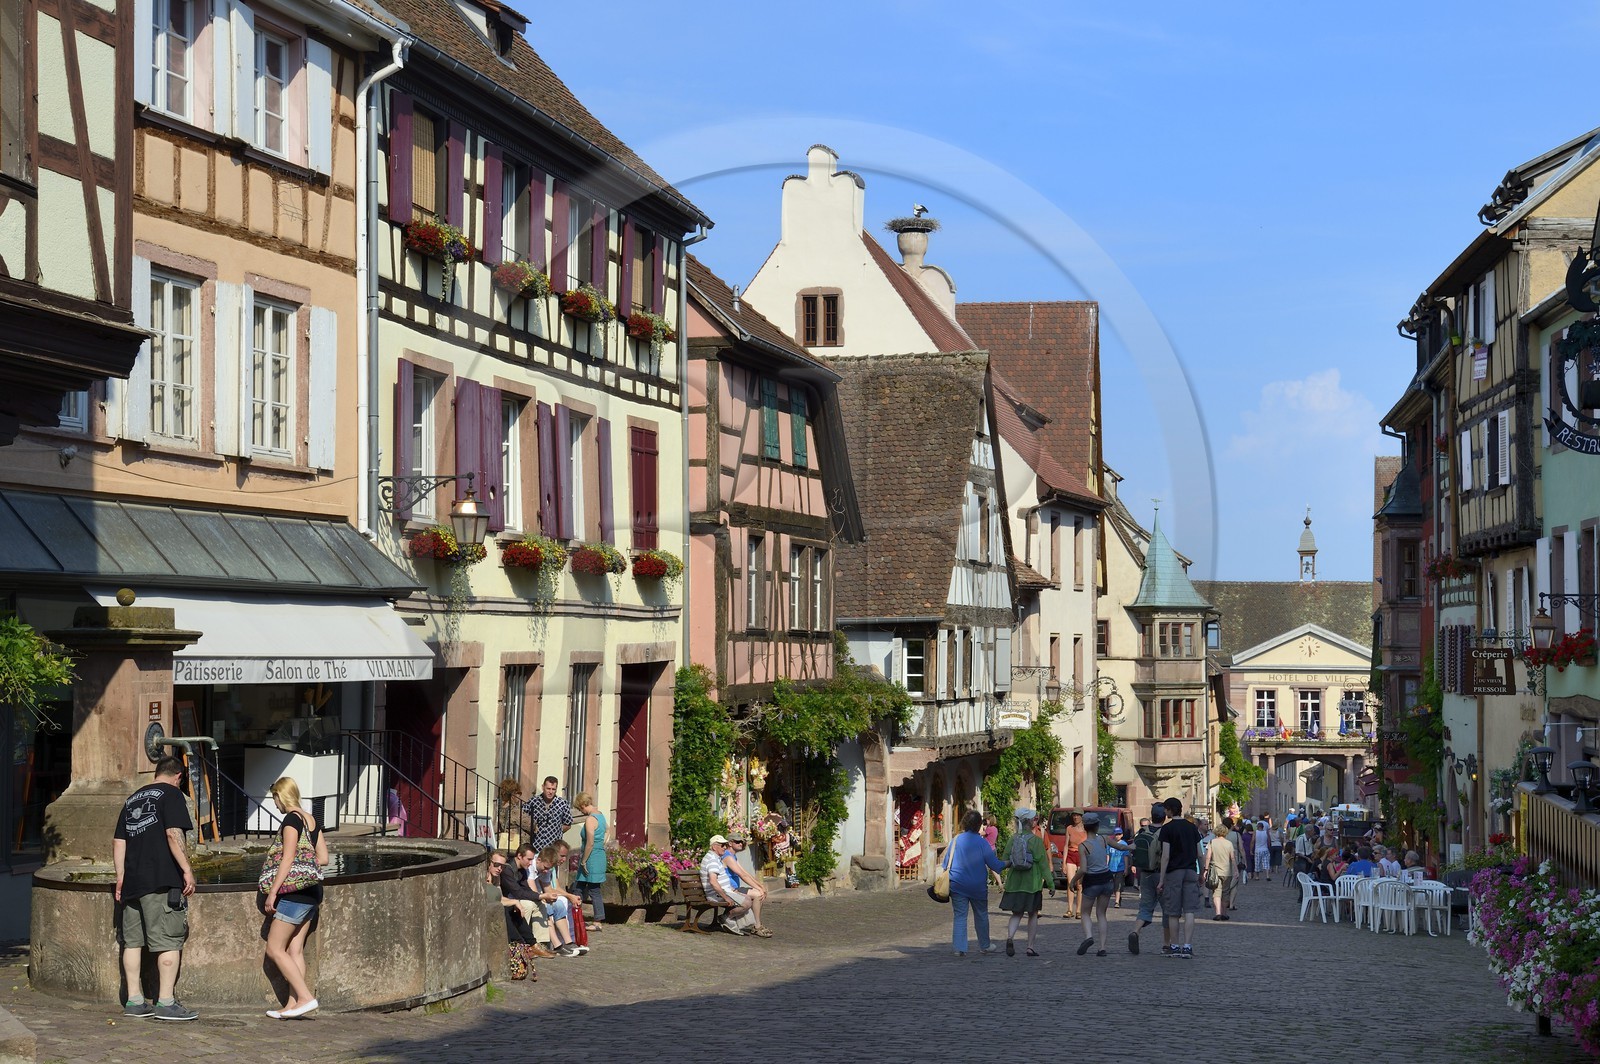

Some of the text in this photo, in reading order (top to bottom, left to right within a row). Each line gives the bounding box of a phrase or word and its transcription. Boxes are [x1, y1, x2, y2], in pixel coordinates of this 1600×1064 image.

[1471, 650, 1508, 659] Crêperie
[174, 659, 416, 682] Pâtisserie Salon de Thé VILMAIN
[1306, 674, 1319, 682] DE
[1325, 674, 1350, 683] VILLE
